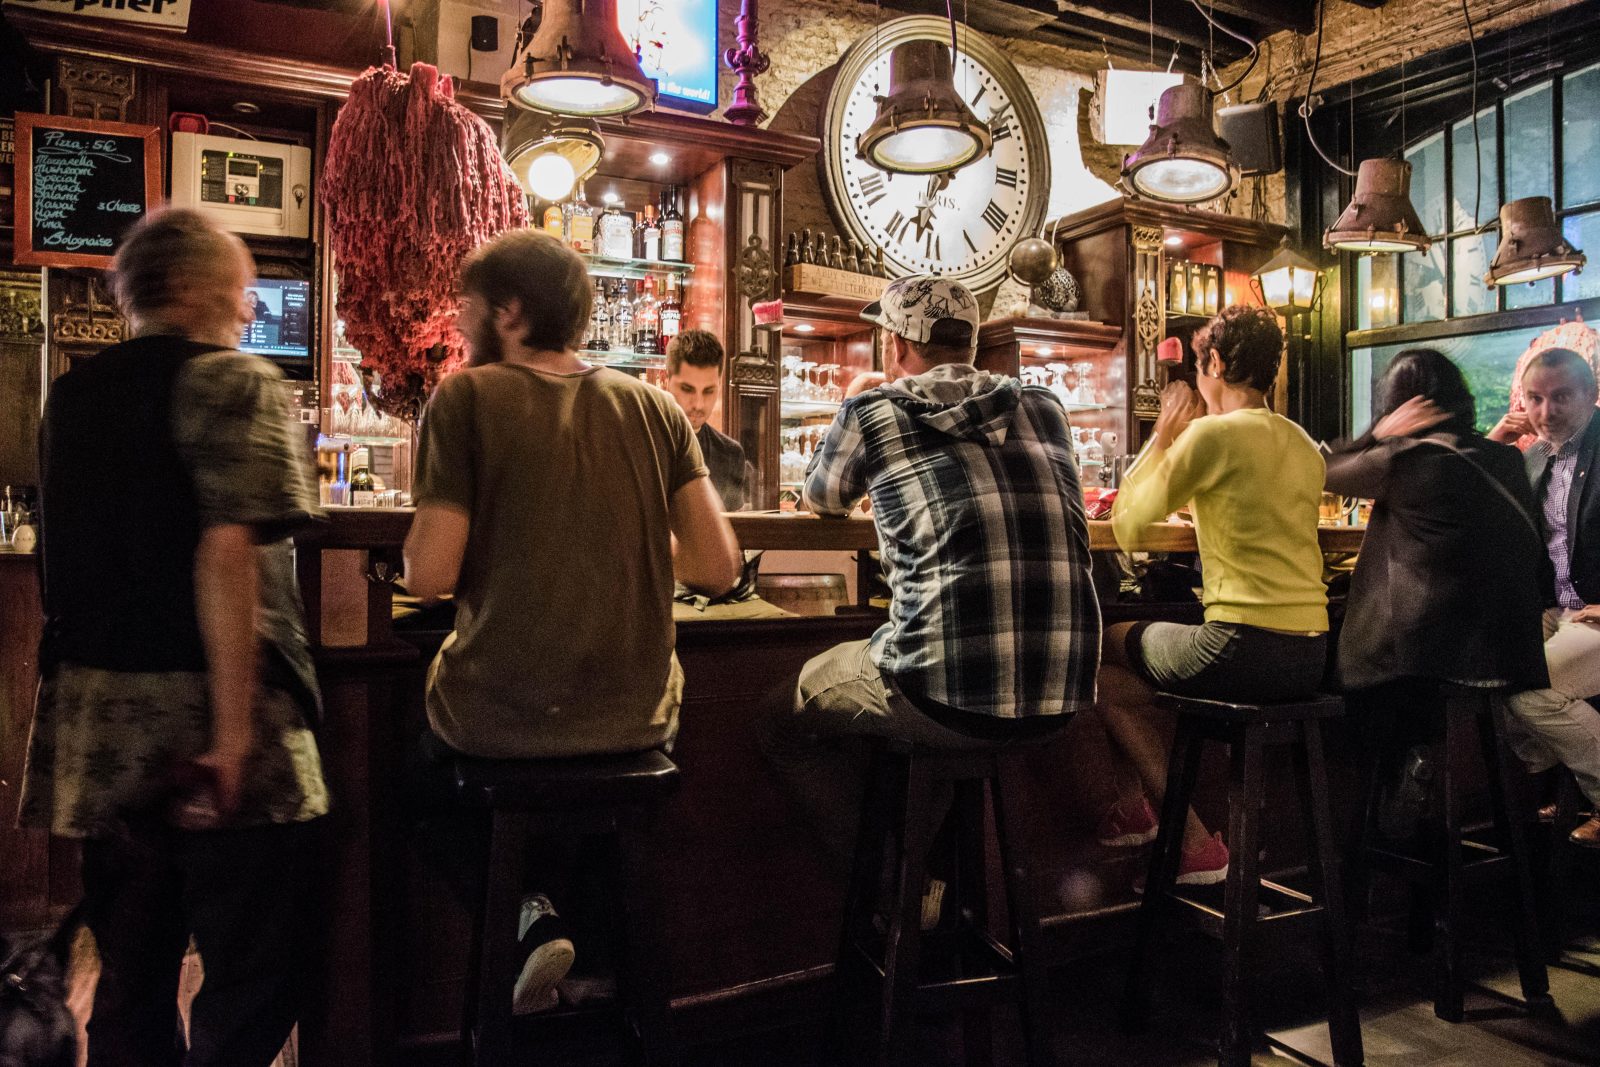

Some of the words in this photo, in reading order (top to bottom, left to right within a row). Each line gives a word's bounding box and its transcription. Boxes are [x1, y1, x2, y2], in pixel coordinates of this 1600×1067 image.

[34, 164, 94, 176] Mushroom
[34, 209, 69, 220] Ham
[35, 216, 67, 230] Tuna
[43, 230, 114, 250] Bolognaise
